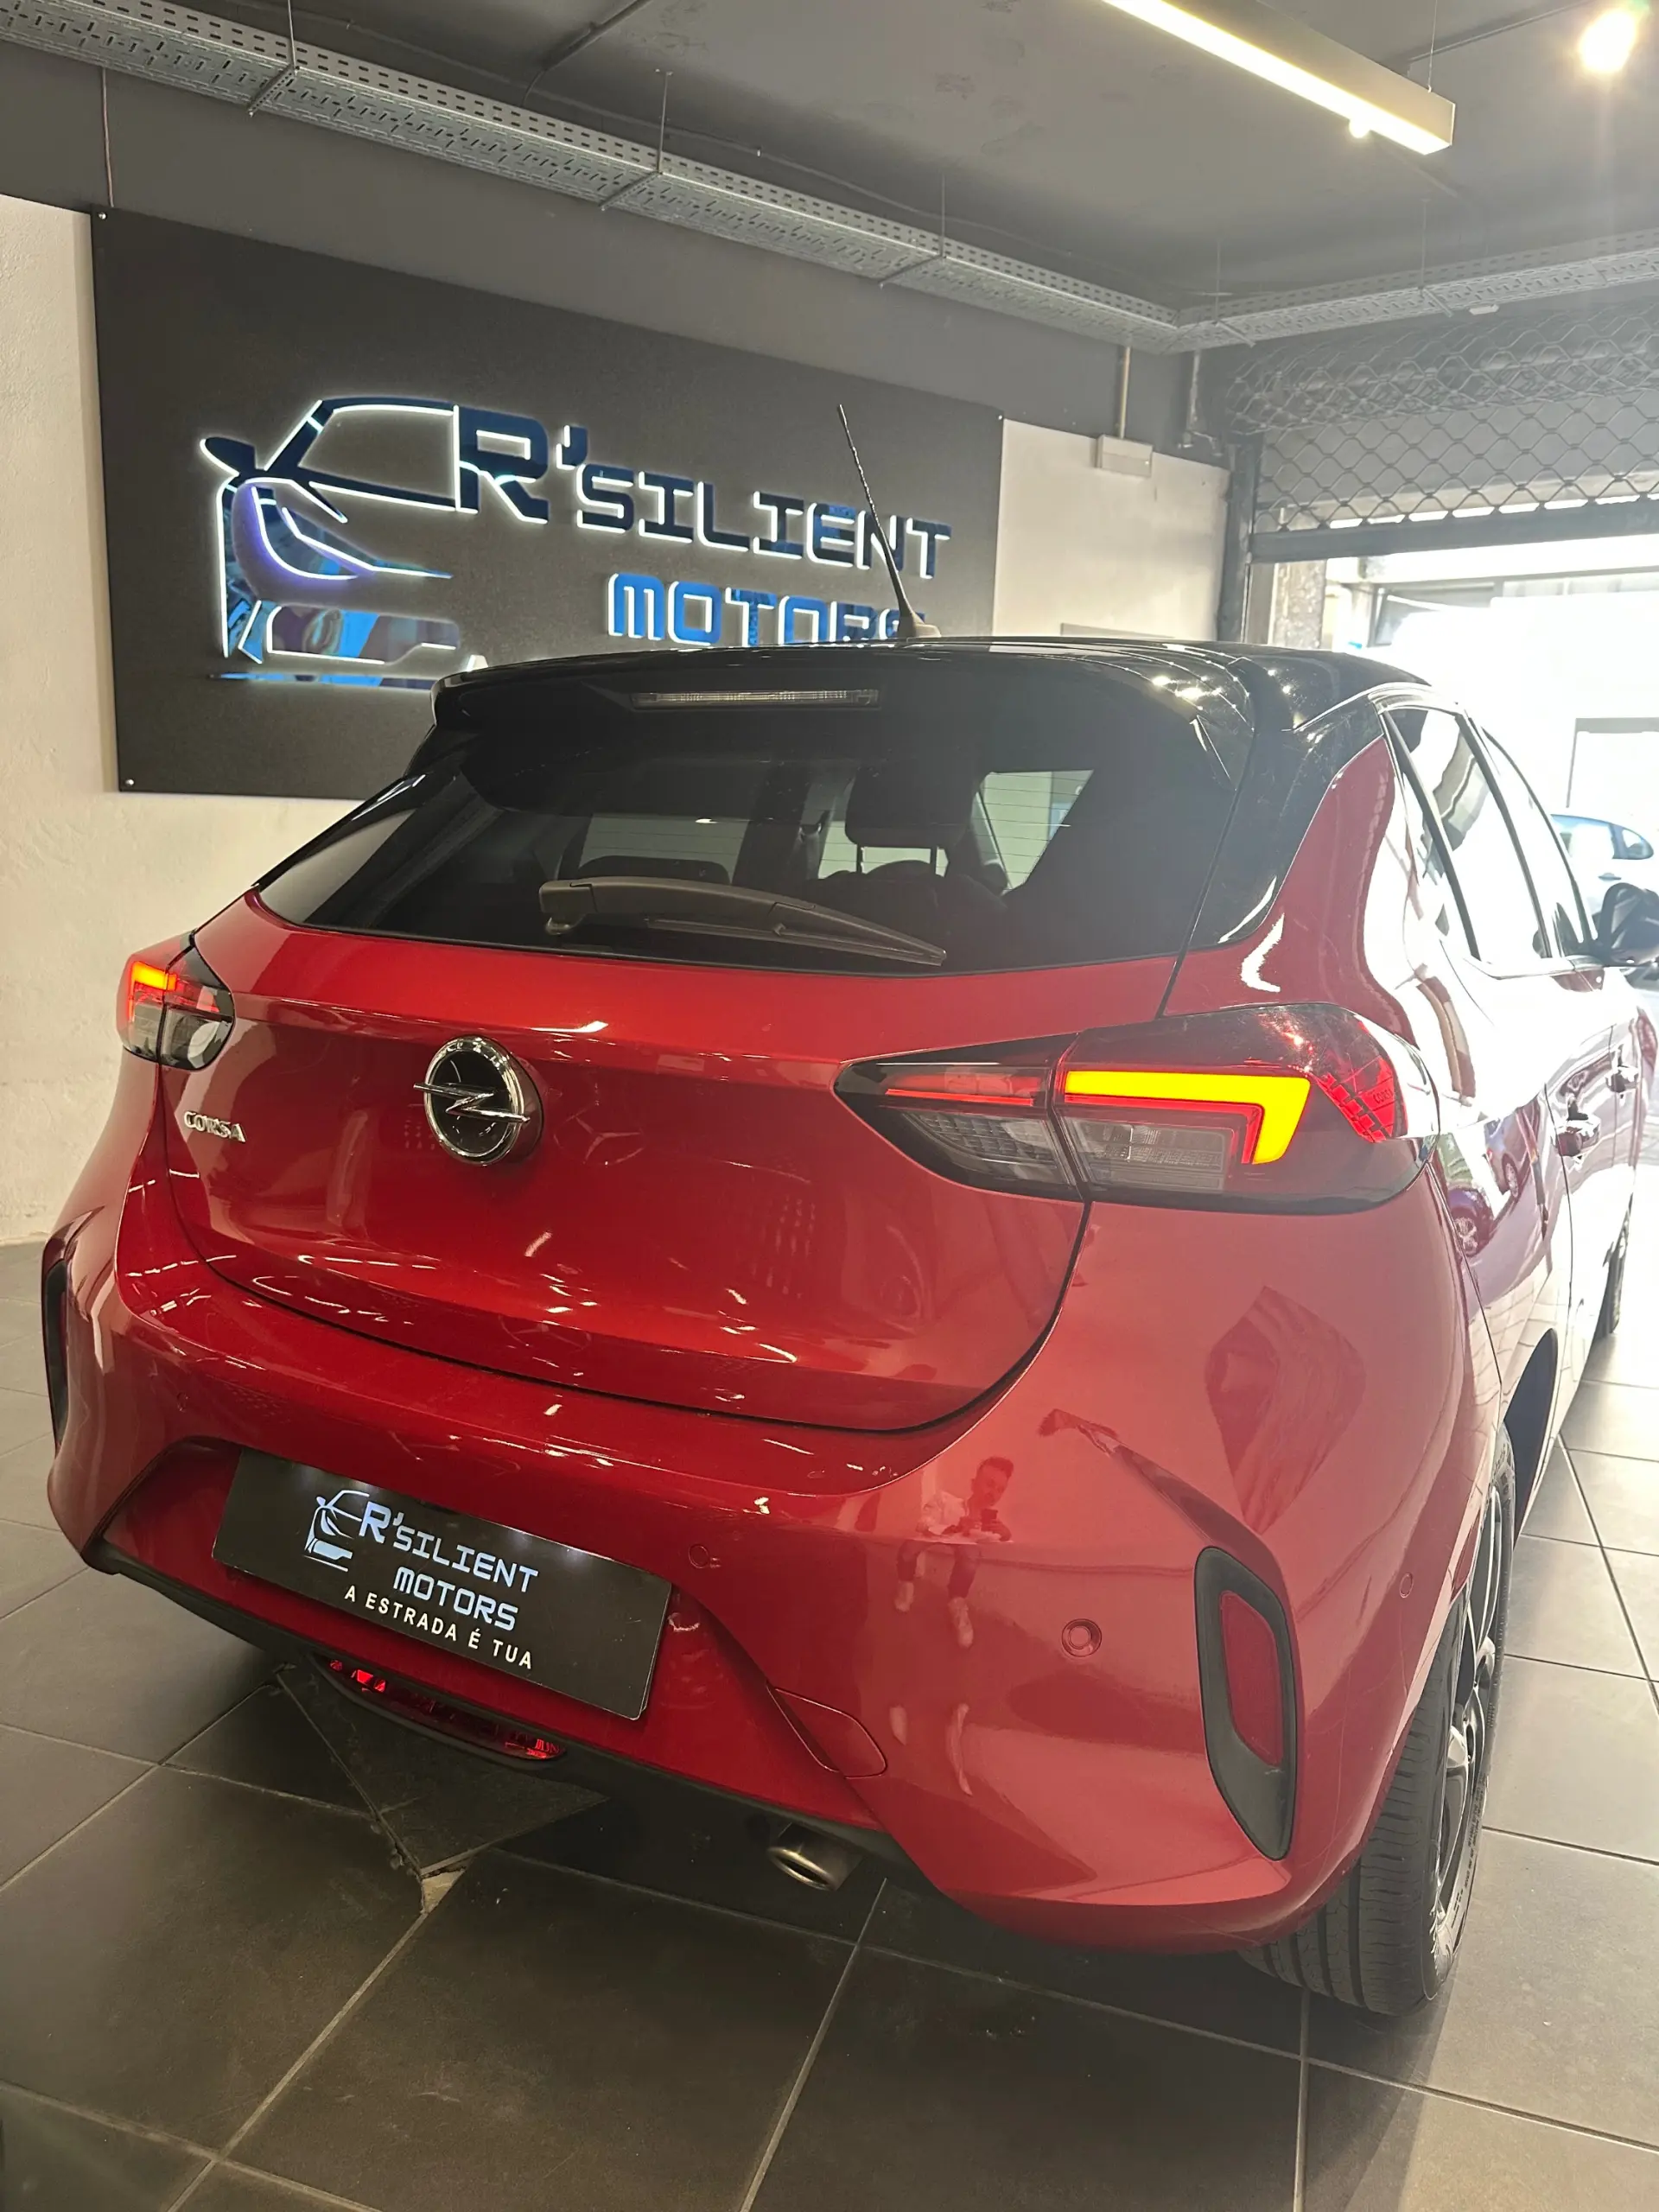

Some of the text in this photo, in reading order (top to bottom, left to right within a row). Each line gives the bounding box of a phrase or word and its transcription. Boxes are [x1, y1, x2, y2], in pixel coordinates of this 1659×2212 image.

[453, 404, 952, 580] R'SILIENT
[184, 1111, 246, 1143] CORSA
[358, 1501, 539, 1593] R'SILIENT
[344, 1585, 532, 1669] A ESTRADA É TUA
[393, 1566, 518, 1631] MOTORS
